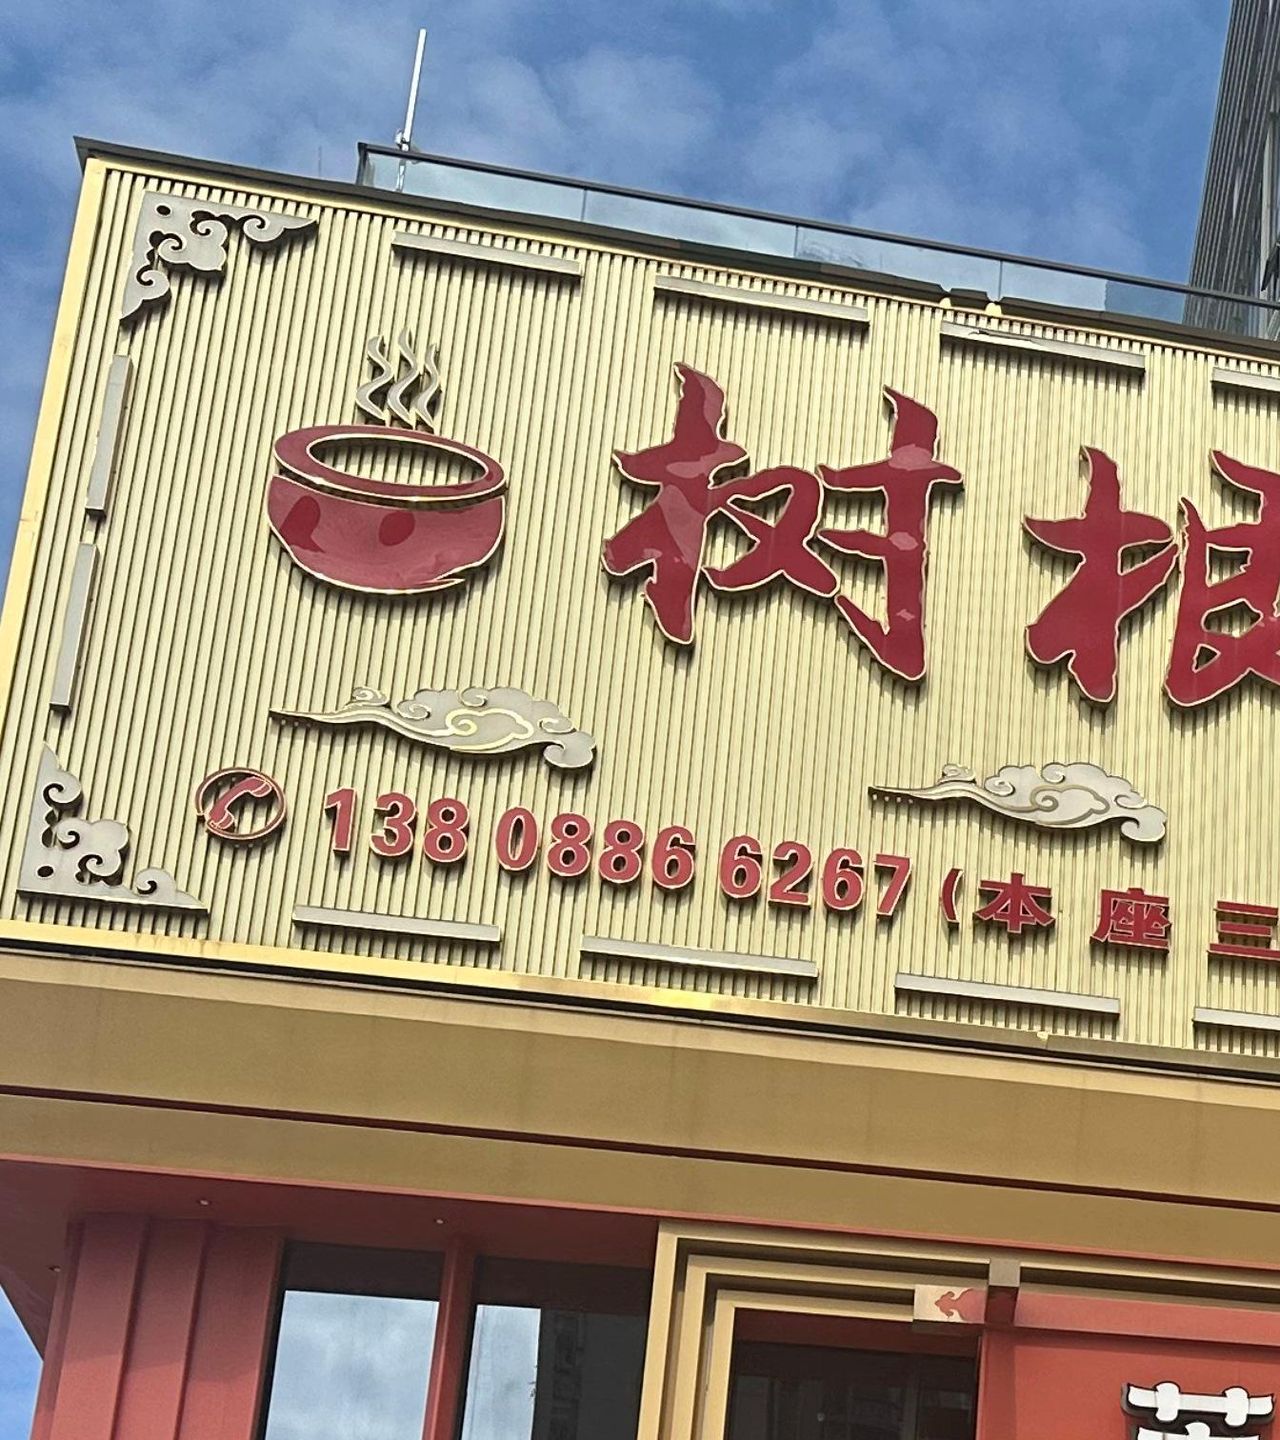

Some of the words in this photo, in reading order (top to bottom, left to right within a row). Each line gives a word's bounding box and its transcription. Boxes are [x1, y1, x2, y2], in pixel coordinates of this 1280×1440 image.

[325, 786, 471, 864] 138
[495, 806, 697, 891] 0886
[718, 834, 913, 919] 6267
